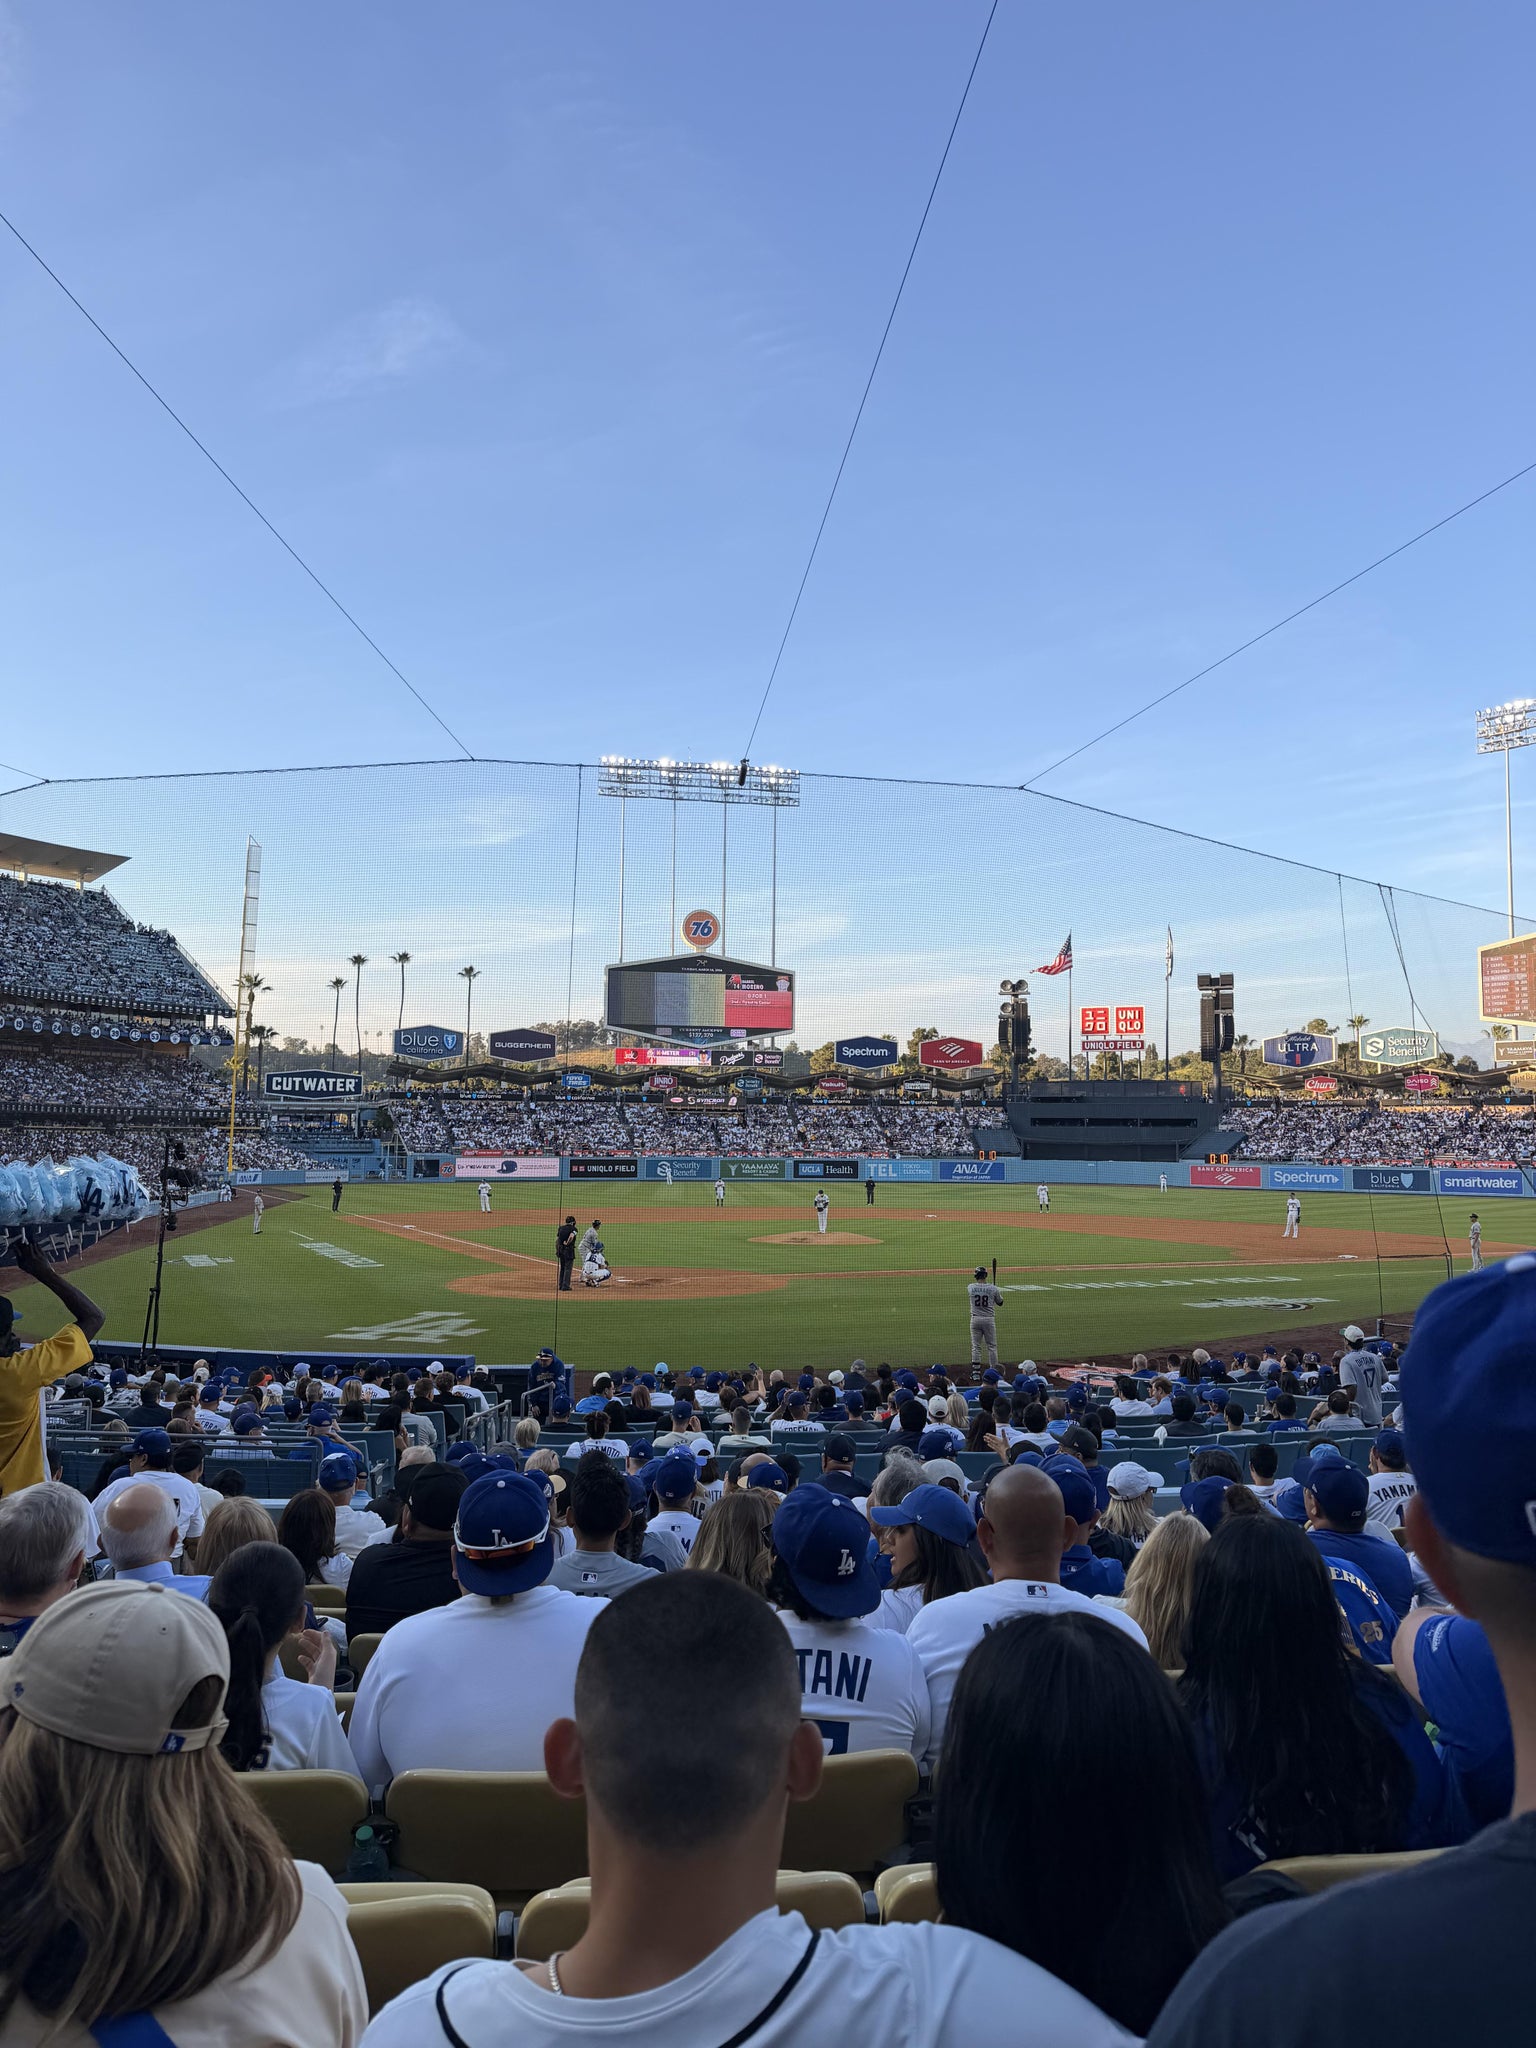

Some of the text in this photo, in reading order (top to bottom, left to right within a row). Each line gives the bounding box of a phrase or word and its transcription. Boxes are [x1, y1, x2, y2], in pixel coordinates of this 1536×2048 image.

[690, 920, 713, 937] 76
[1085, 1010, 1105, 1020] ユニ
[1118, 1010, 1138, 1019] UNI
[1085, 1021, 1106, 1031] クロ
[1118, 1020, 1141, 1032] QLO
[91, 1028, 100, 1037] 34
[131, 1030, 141, 1039] 42
[401, 1031, 439, 1046] blue
[1387, 1036, 1429, 1047] Security
[495, 1041, 552, 1049] GUGGENHEIM
[1084, 1041, 1142, 1050] UNIQLO FIELD
[1278, 1042, 1319, 1052] ULTRA
[842, 1046, 888, 1058] Spectrum
[1389, 1046, 1423, 1056] Benefit
[720, 1052, 745, 1065] Dodgers
[272, 1077, 355, 1092] CUTWATER
[654, 1077, 673, 1086] JINRO
[1306, 1079, 1336, 1089] Churu
[442, 1165, 452, 1173] 76
[673, 1161, 700, 1169] Security
[802, 1165, 853, 1174] UCLA Health
[867, 1163, 897, 1177] TEL
[952, 1164, 978, 1174] ANA
[673, 1169, 697, 1177] Benefit
[1274, 1171, 1334, 1184] Spectrum
[1371, 1173, 1399, 1184] blue
[1445, 1177, 1516, 1189] smartwater
[974, 1294, 989, 1307] 28
[1364, 1368, 1375, 1387] 17
[837, 1549, 856, 1576] LA
[1360, 1621, 1384, 1644] 25
[795, 1648, 872, 1703] TANI
